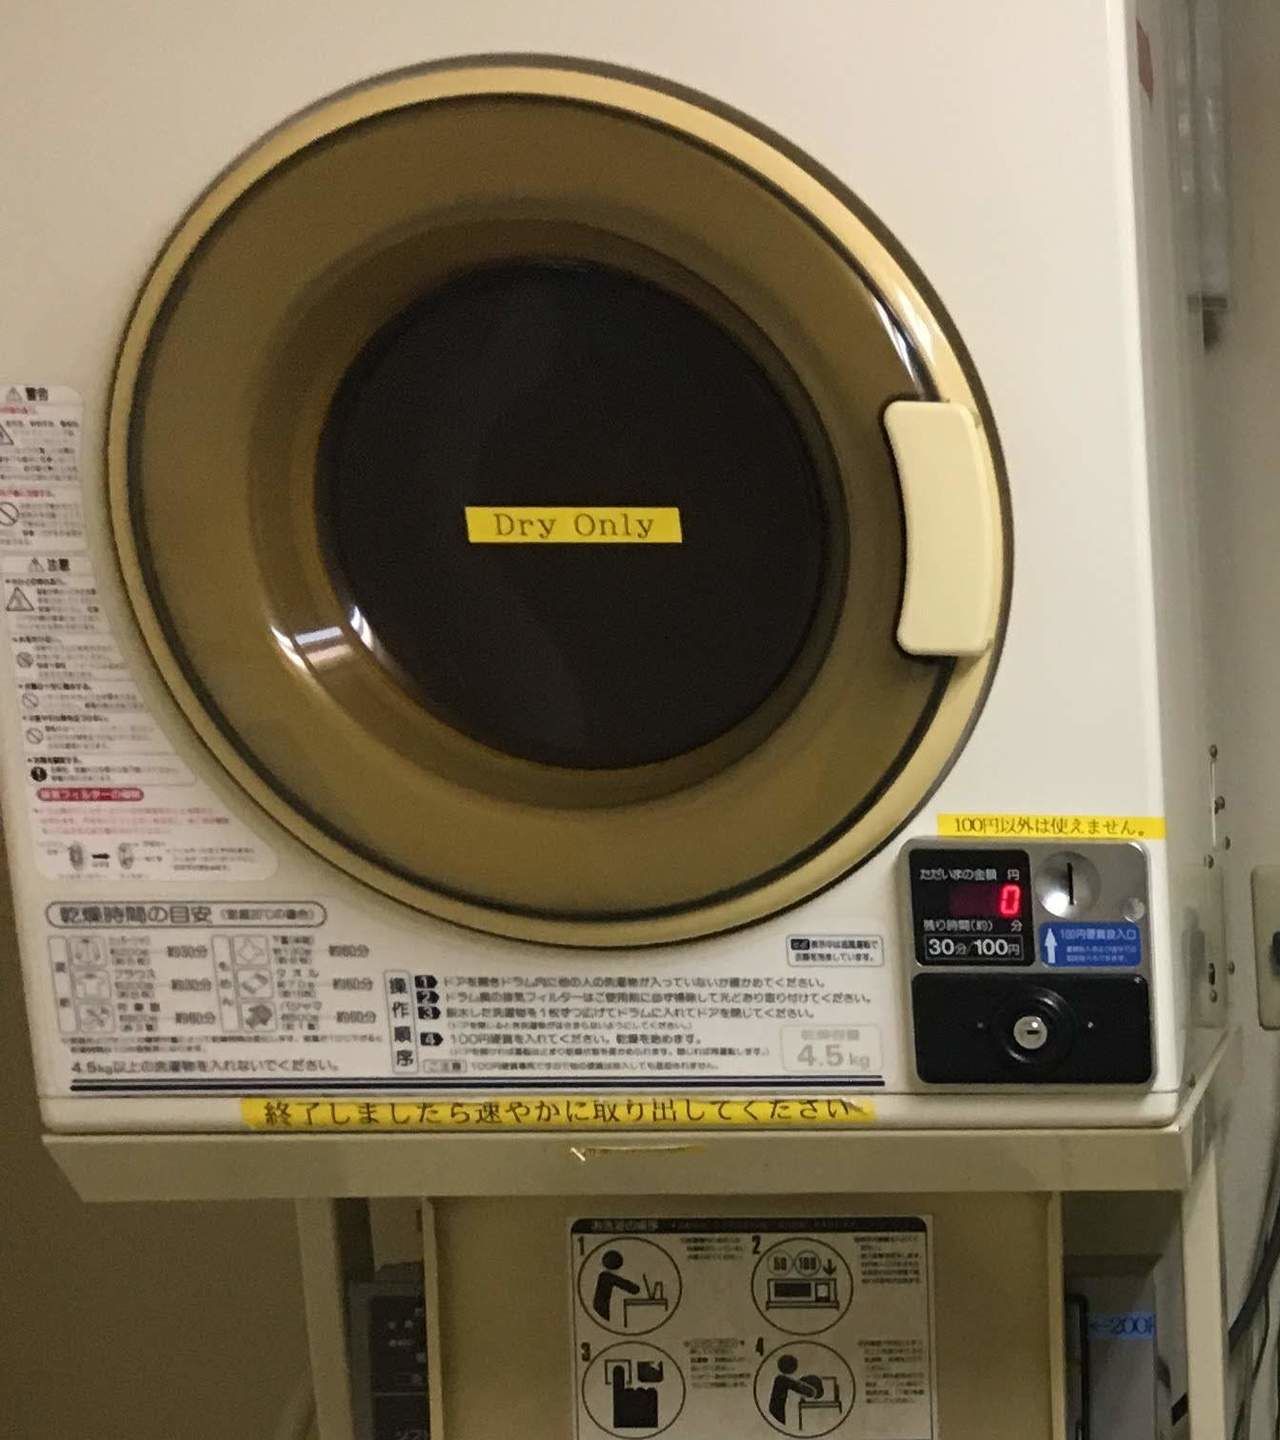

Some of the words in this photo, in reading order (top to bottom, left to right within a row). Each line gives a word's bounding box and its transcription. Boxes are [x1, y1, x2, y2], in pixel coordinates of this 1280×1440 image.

[493, 513, 556, 539] Dry
[574, 513, 654, 539] Only
[954, 816, 1145, 838] 100円以外は使えません。
[1000, 884, 1021, 916] 0
[577, 1236, 585, 1256] 1
[752, 1235, 761, 1255] 2
[581, 1342, 591, 1362] 3
[755, 1337, 765, 1357] 4
